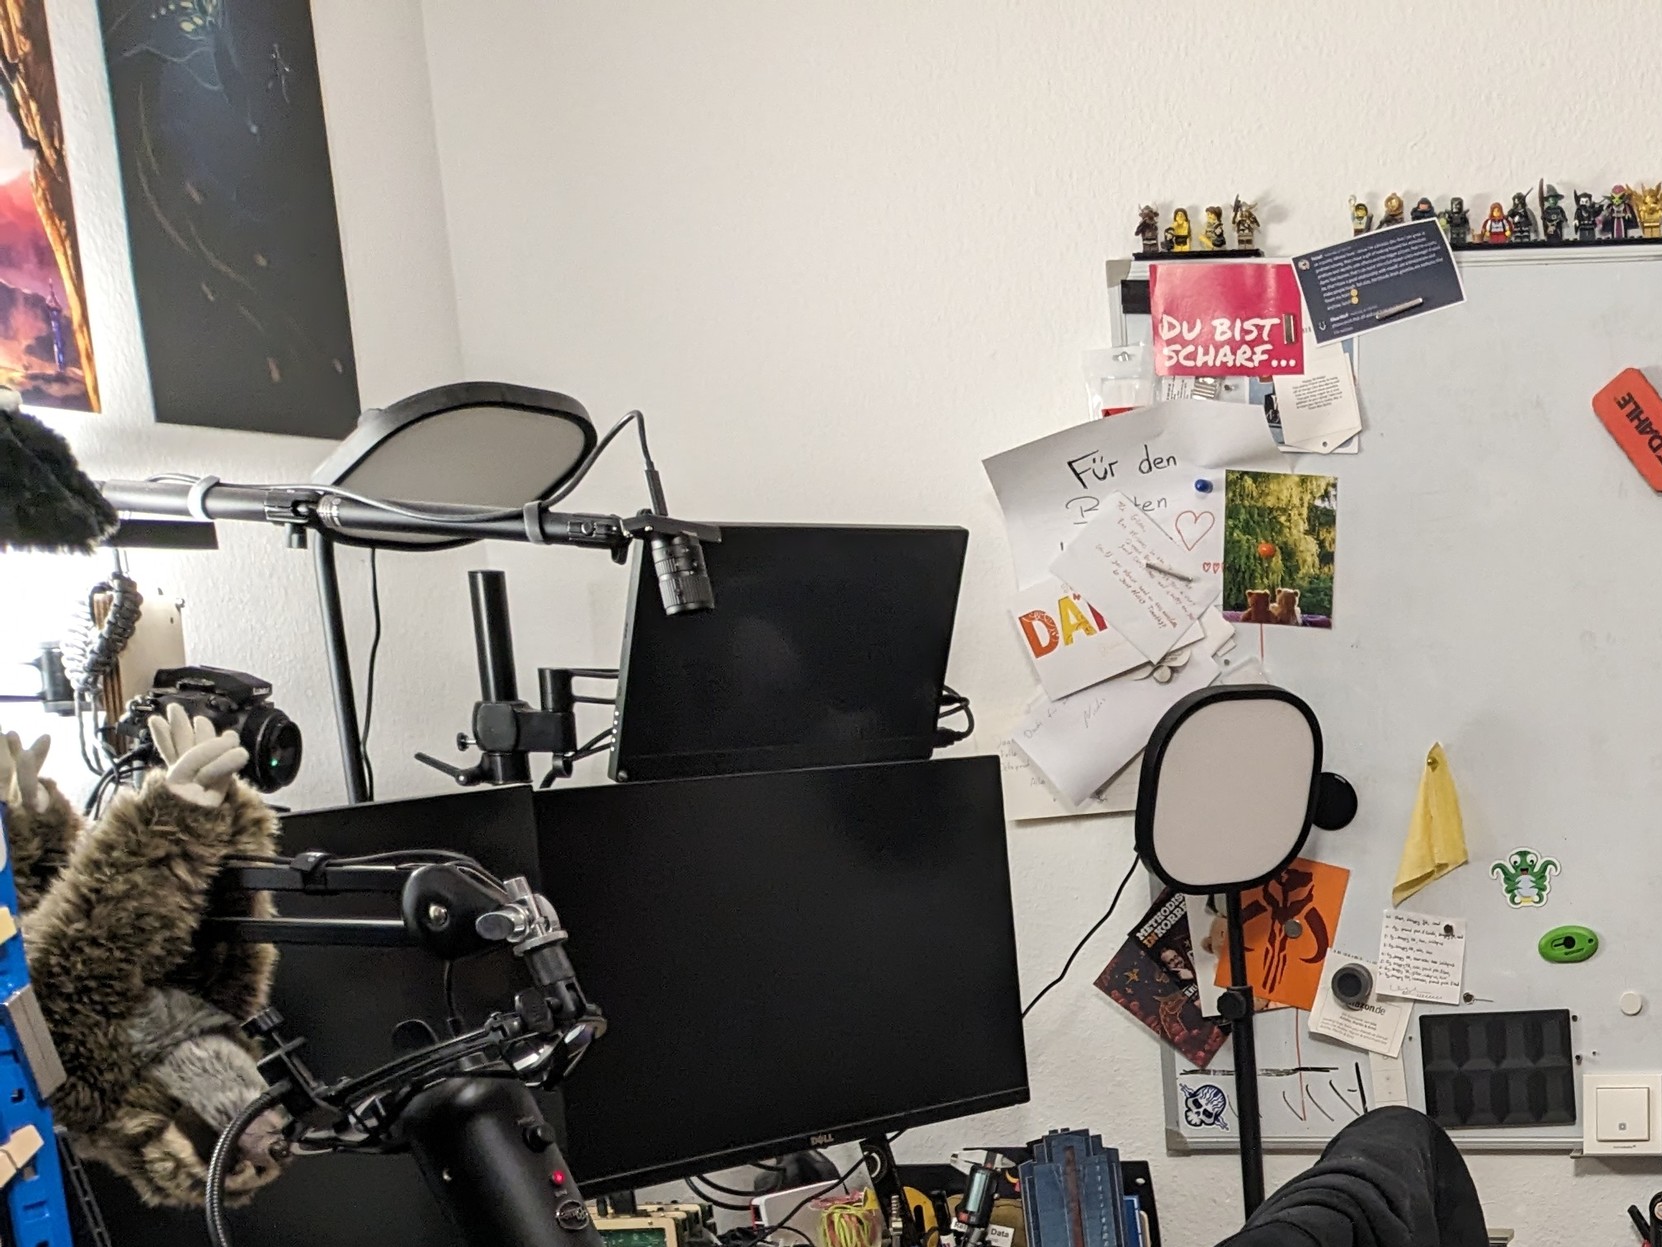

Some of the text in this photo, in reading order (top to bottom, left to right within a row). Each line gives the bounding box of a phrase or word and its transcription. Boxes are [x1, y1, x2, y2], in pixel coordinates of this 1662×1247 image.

[1159, 314, 1281, 342] DU BIST
[1162, 344, 1296, 368] SCHARF...
[1067, 444, 1178, 489] Für den
[990, 1227, 1010, 1239] Data
